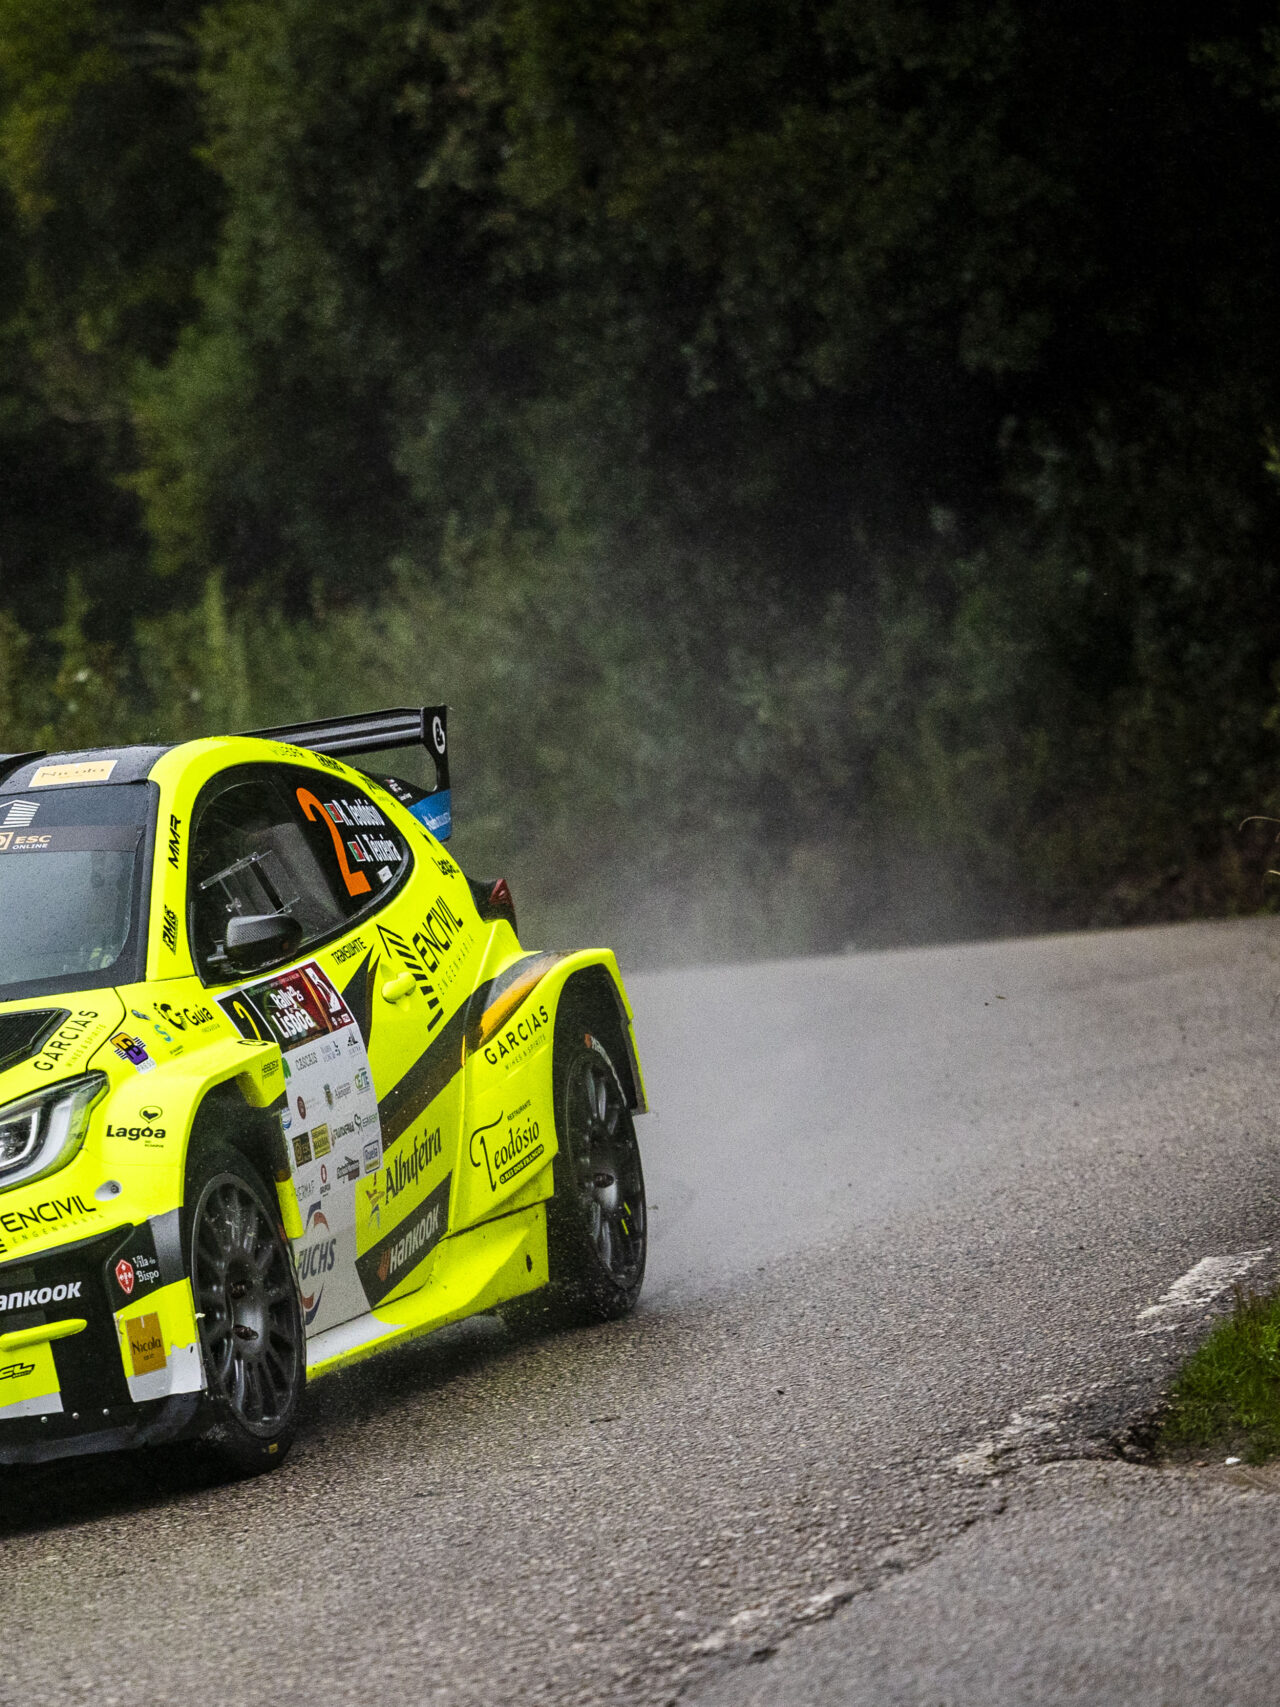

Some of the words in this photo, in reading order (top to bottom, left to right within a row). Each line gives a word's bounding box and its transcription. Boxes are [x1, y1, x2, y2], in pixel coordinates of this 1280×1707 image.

[331, 799, 355, 826] R.
[14, 834, 52, 845] ESC
[168, 813, 182, 870] MMR
[296, 787, 372, 897] 2
[412, 895, 464, 974] ENCIVIL
[270, 987, 297, 1010] Rally
[33, 1009, 99, 1071] GARCIAS
[232, 1000, 262, 1041] 2
[271, 1008, 316, 1039] Lisboa
[484, 1005, 550, 1065] GARCIAS
[385, 1126, 442, 1205] Albufeira
[469, 1110, 540, 1192] Teodósio
[0, 1195, 97, 1232] ENCIVIL
[132, 1255, 149, 1268] Vila
[136, 1269, 160, 1284] Bispo
[132, 1336, 162, 1355] Nicola
